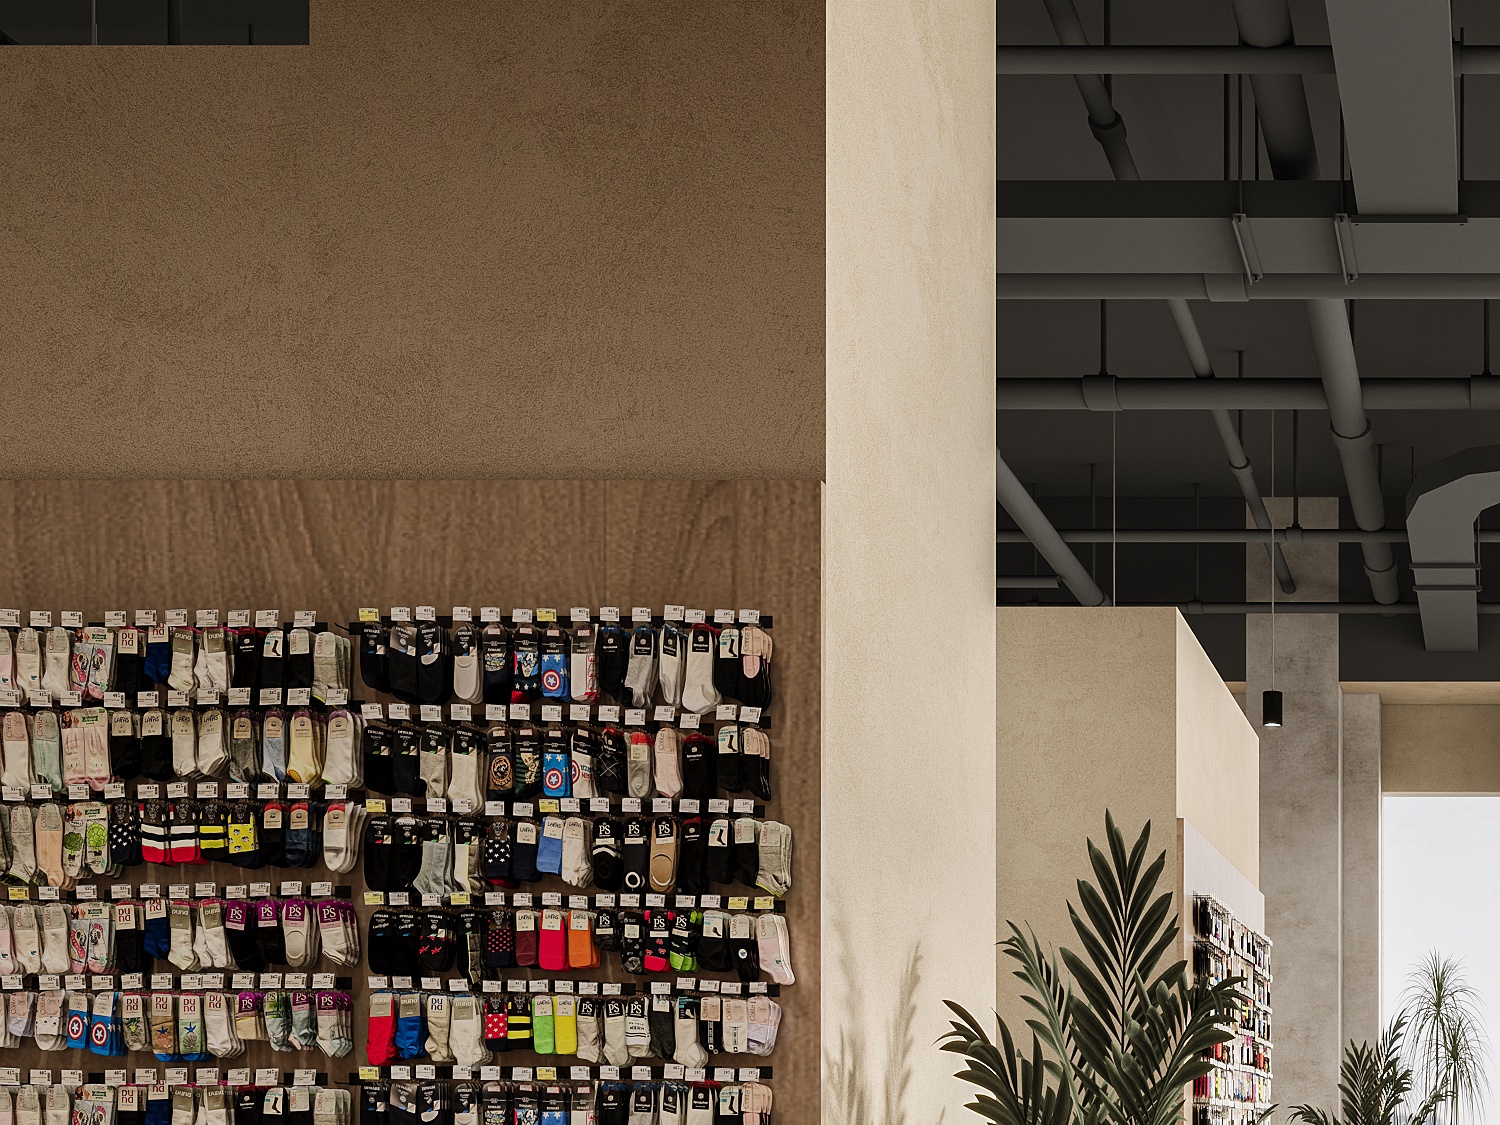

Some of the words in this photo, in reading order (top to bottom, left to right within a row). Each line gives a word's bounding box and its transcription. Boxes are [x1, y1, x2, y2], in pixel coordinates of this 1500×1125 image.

[599, 824, 610, 835] PS
[628, 824, 640, 834] PS
[658, 823, 670, 834] PS
[230, 909, 242, 919] PS
[261, 907, 273, 917] PS
[289, 907, 301, 917] PS
[323, 908, 336, 918] PS
[599, 915, 610, 925] PS
[654, 918, 665, 928] PS
[676, 917, 687, 928] PS
[296, 992, 306, 1001] PS
[321, 996, 333, 1006] PS
[242, 999, 253, 1009] PS
[582, 1004, 592, 1013] PS
[608, 1003, 620, 1014] PS
[630, 1004, 642, 1014] PS
